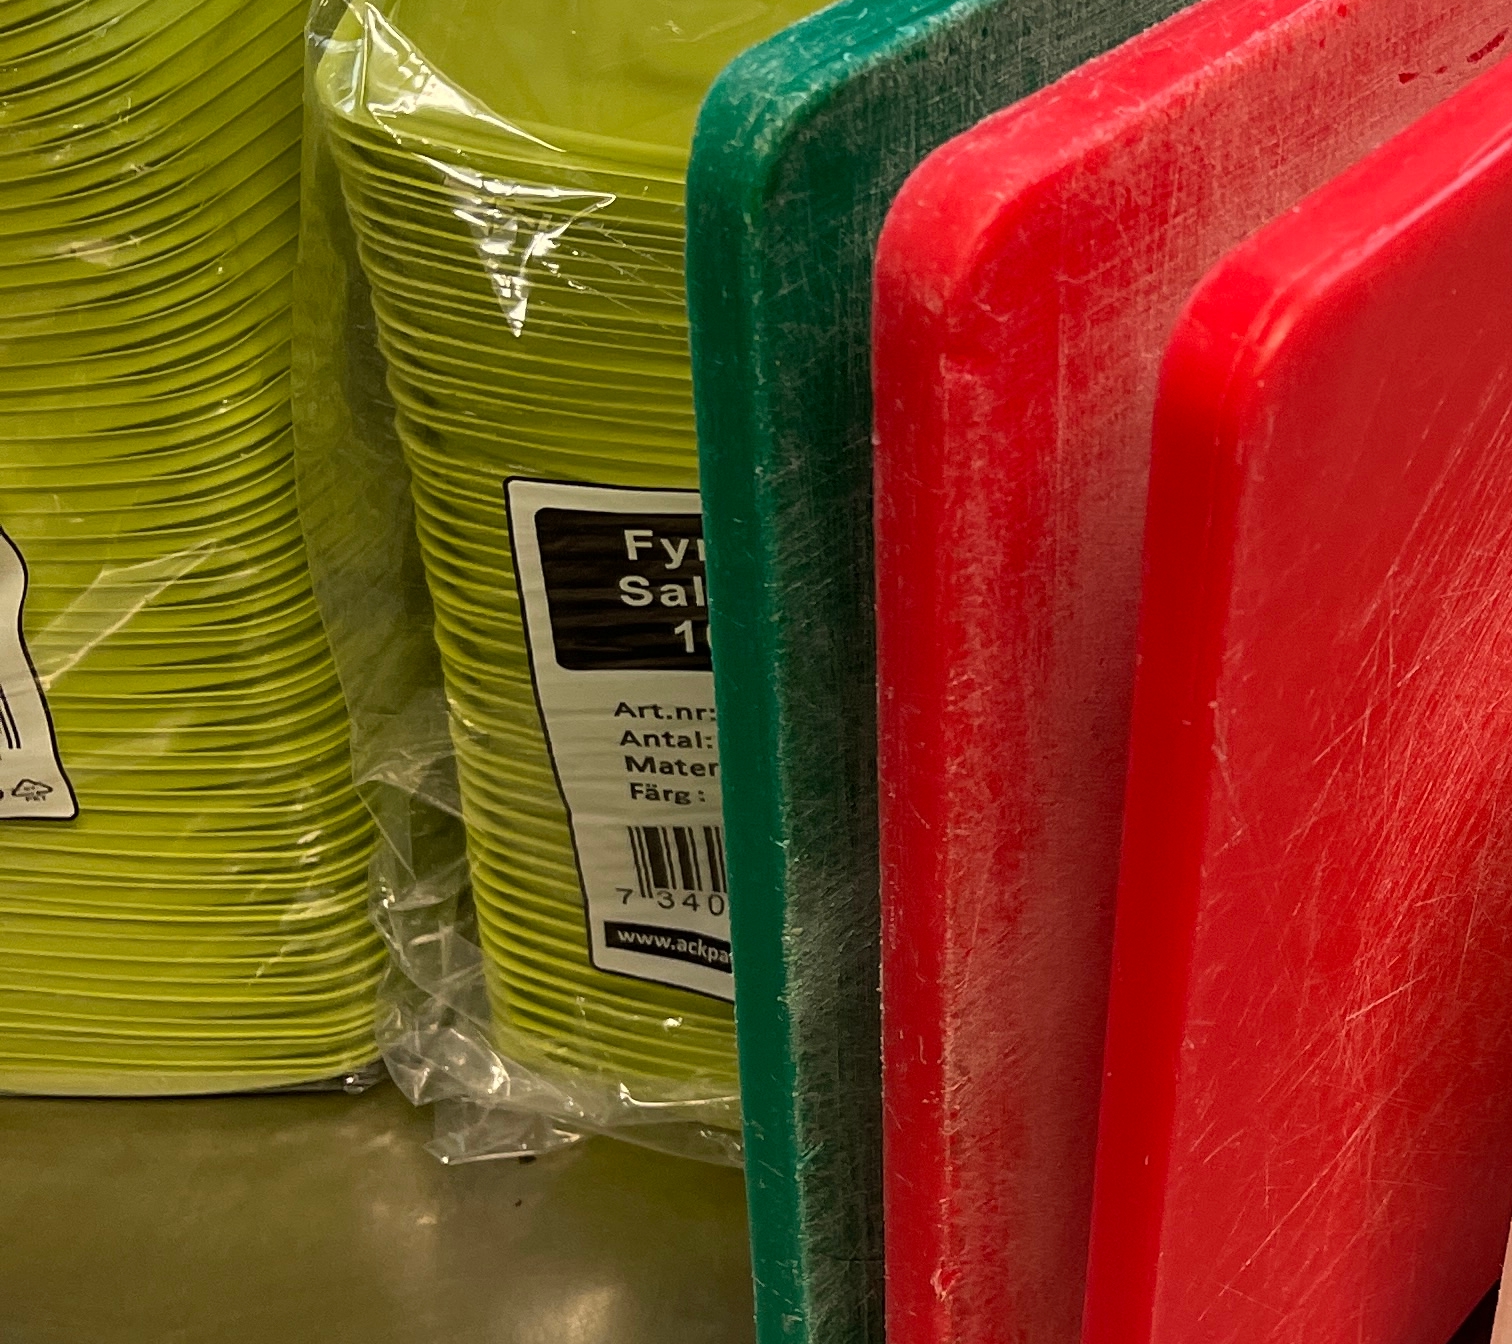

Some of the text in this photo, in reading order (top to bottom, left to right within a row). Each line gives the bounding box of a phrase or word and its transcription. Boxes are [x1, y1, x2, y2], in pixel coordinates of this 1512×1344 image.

[618, 575, 705, 607] Sal
[674, 619, 712, 653] 1
[614, 701, 717, 722] Art.nr:
[620, 729, 713, 749] Antal:
